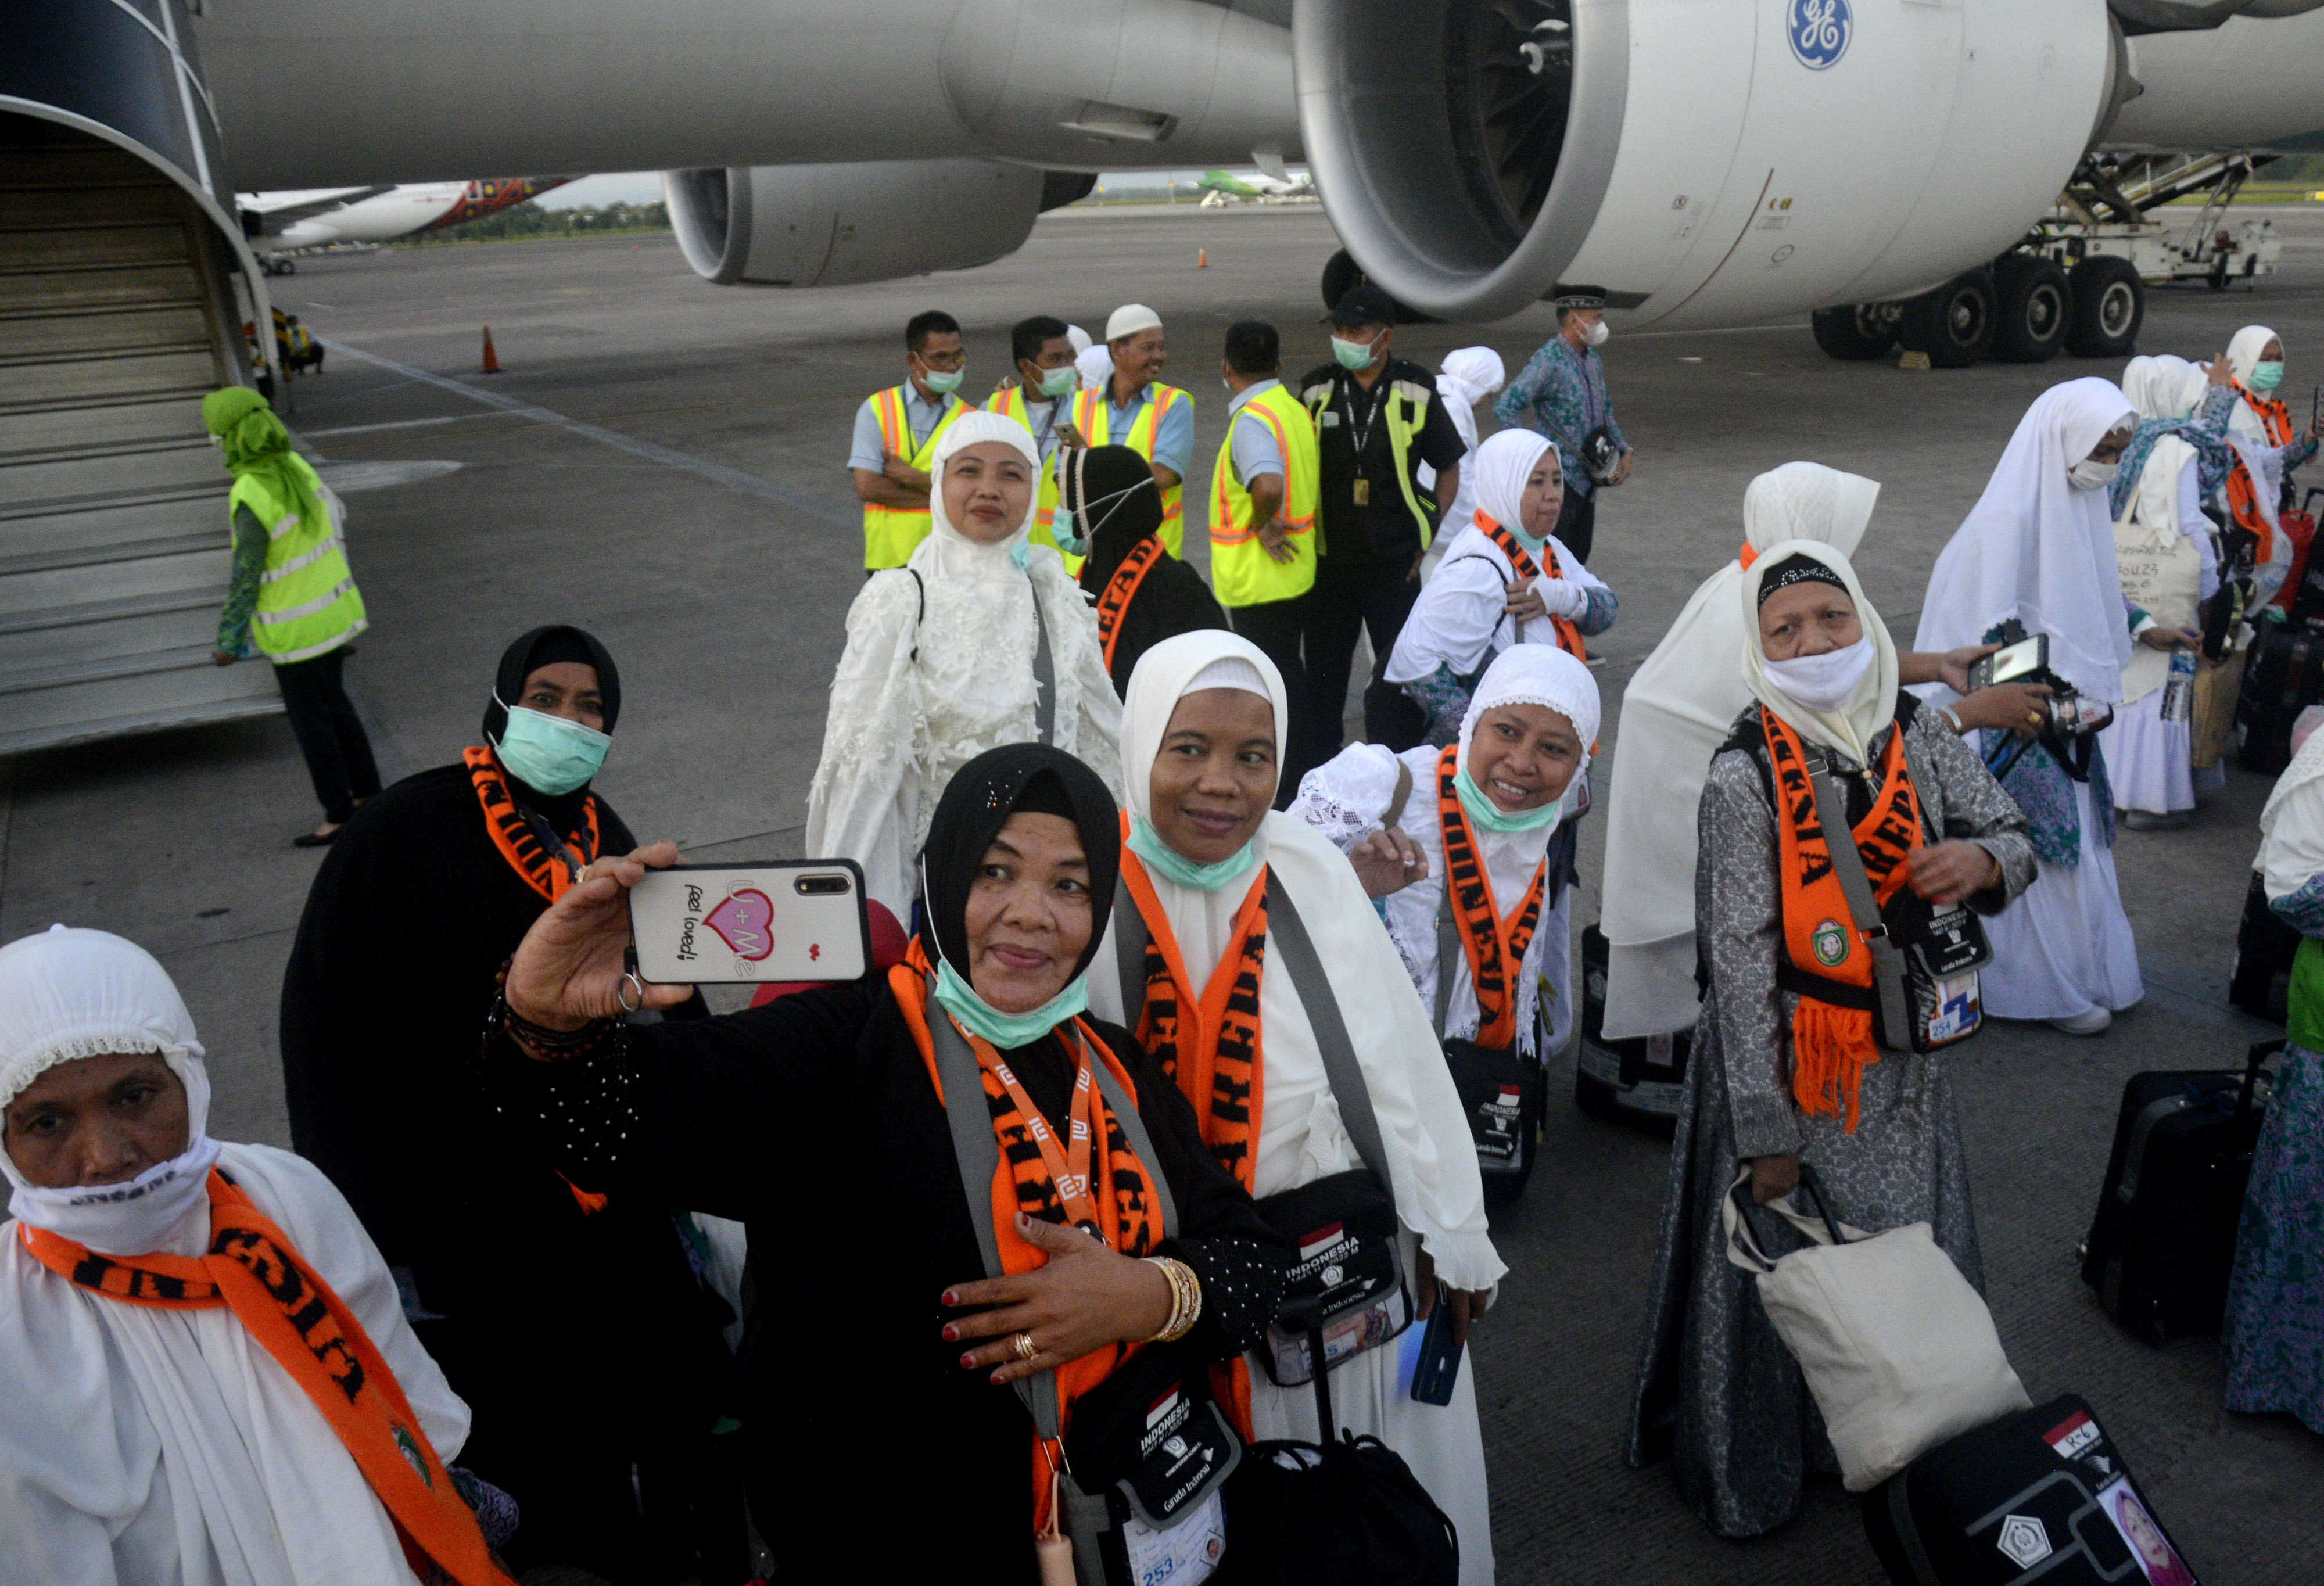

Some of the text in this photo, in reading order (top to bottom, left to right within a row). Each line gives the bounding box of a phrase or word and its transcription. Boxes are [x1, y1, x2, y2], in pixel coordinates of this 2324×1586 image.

[677, 884, 703, 961] feel loved!
[1932, 1020, 1951, 1037] 254
[1286, 1237, 1360, 1278] INDONESIA
[1141, 1397, 1191, 1452] INDONESIA
[1164, 1463, 1211, 1512] Garuda Indonesia
[1143, 1558, 1174, 1586] 253
